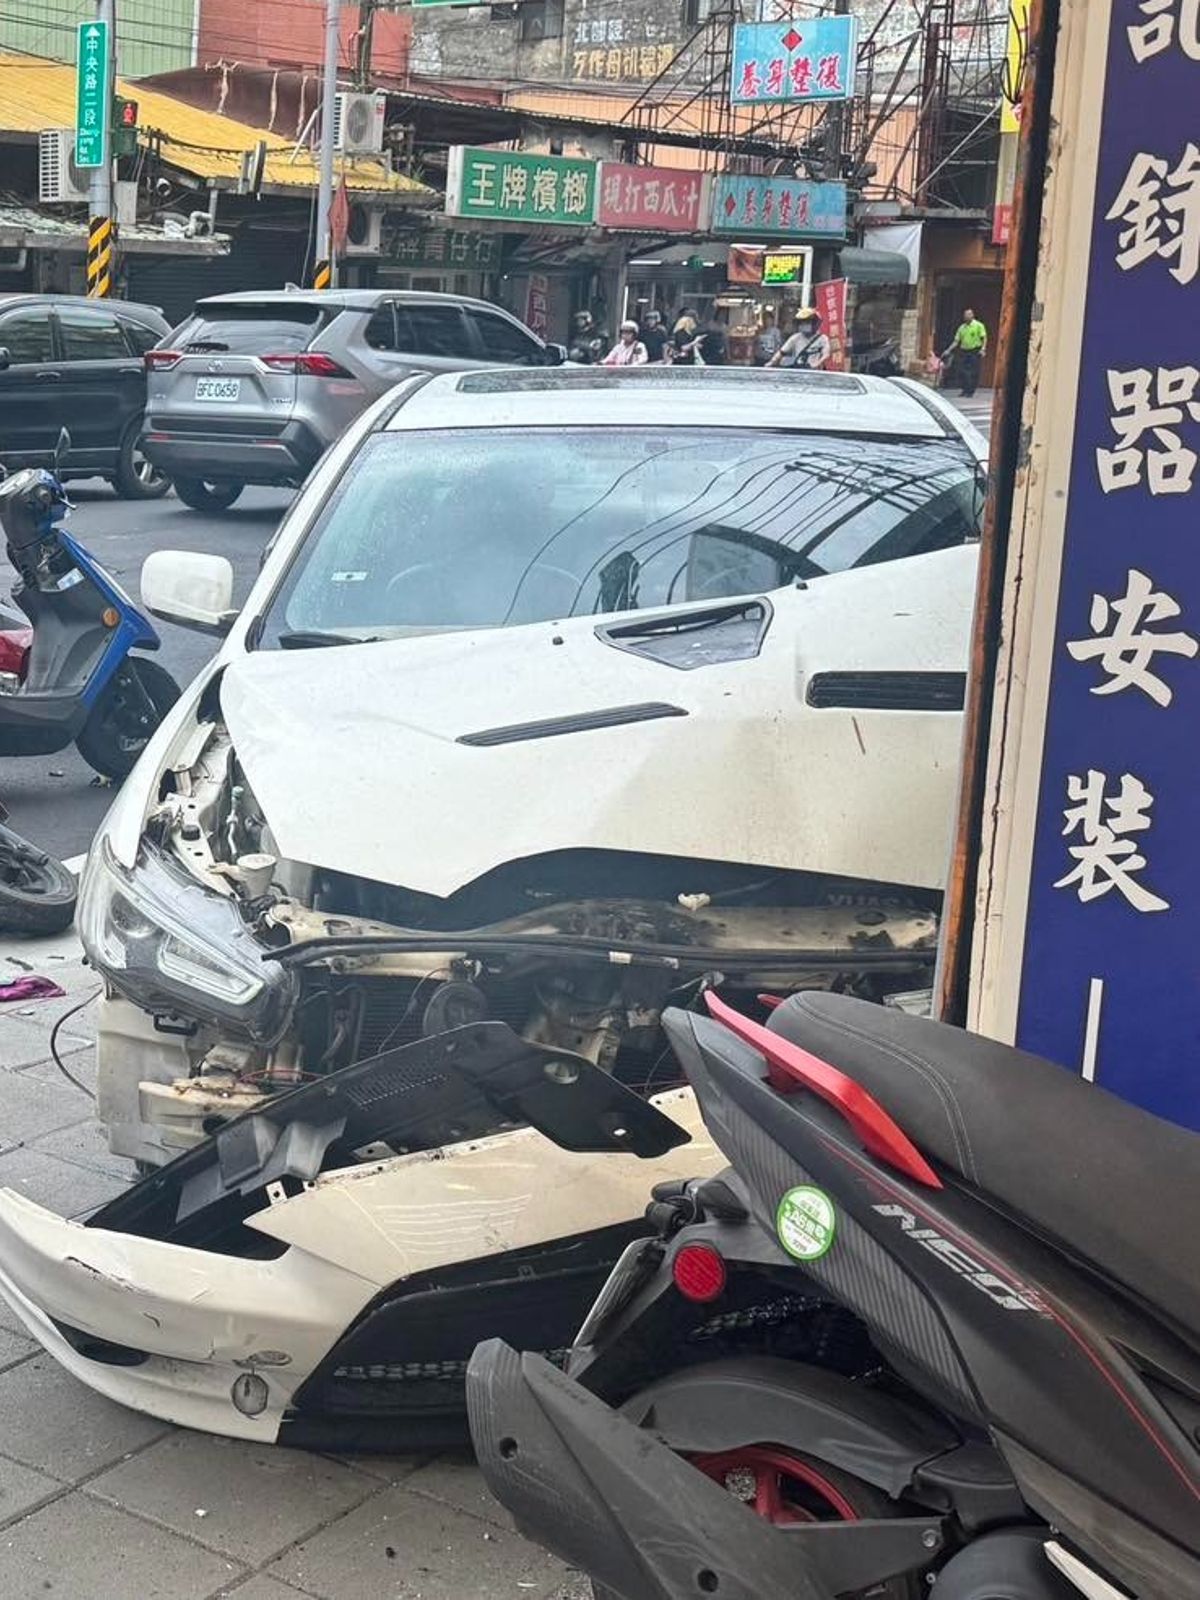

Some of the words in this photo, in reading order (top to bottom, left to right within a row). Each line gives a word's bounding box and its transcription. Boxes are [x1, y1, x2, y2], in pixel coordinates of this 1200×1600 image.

[84, 36, 99, 126] 中央路二段
[737, 55, 842, 97] 養身整復
[468, 162, 588, 214] 王牌檳榔
[604, 174, 698, 220] 現打西瓜汁
